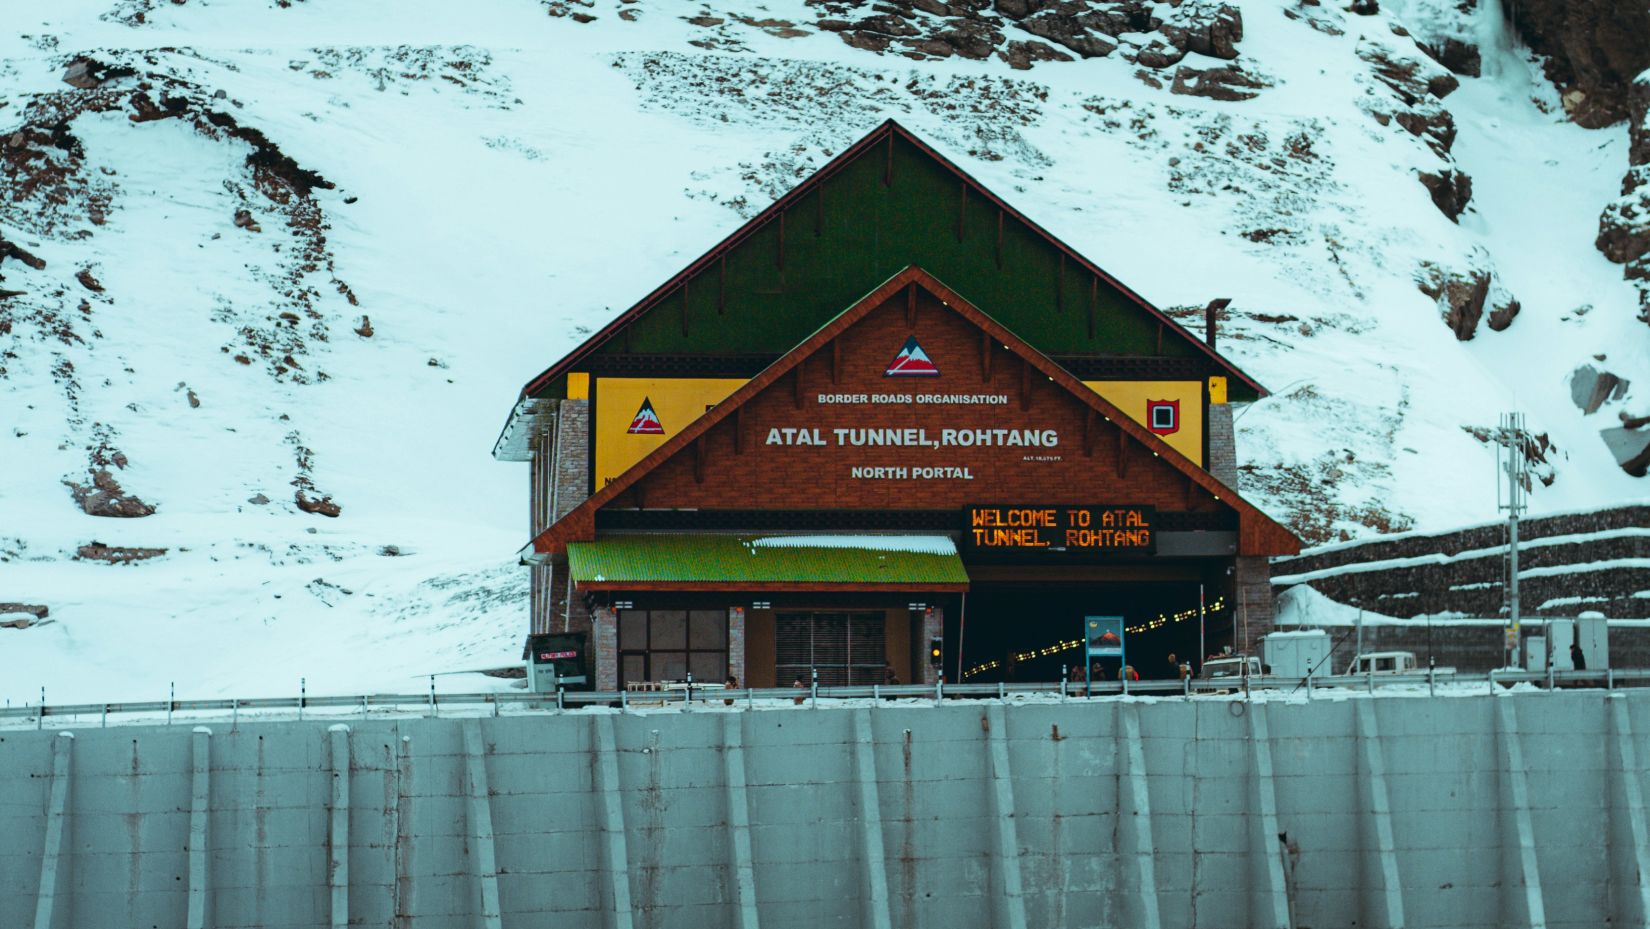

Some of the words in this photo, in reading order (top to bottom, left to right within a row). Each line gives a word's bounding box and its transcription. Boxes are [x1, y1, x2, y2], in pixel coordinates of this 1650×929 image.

[817, 394, 869, 404] BORDER
[871, 394, 913, 404] ROADS
[915, 395, 1008, 405] ORGANISATION
[765, 428, 827, 446] ATAL
[851, 467, 907, 479] NORTH
[912, 467, 974, 479] PORTAL
[973, 509, 1057, 527] WELCOME
[1068, 509, 1091, 527] TO
[1103, 510, 1150, 527] ATAL
[1067, 530, 1150, 547] ROHTANG
